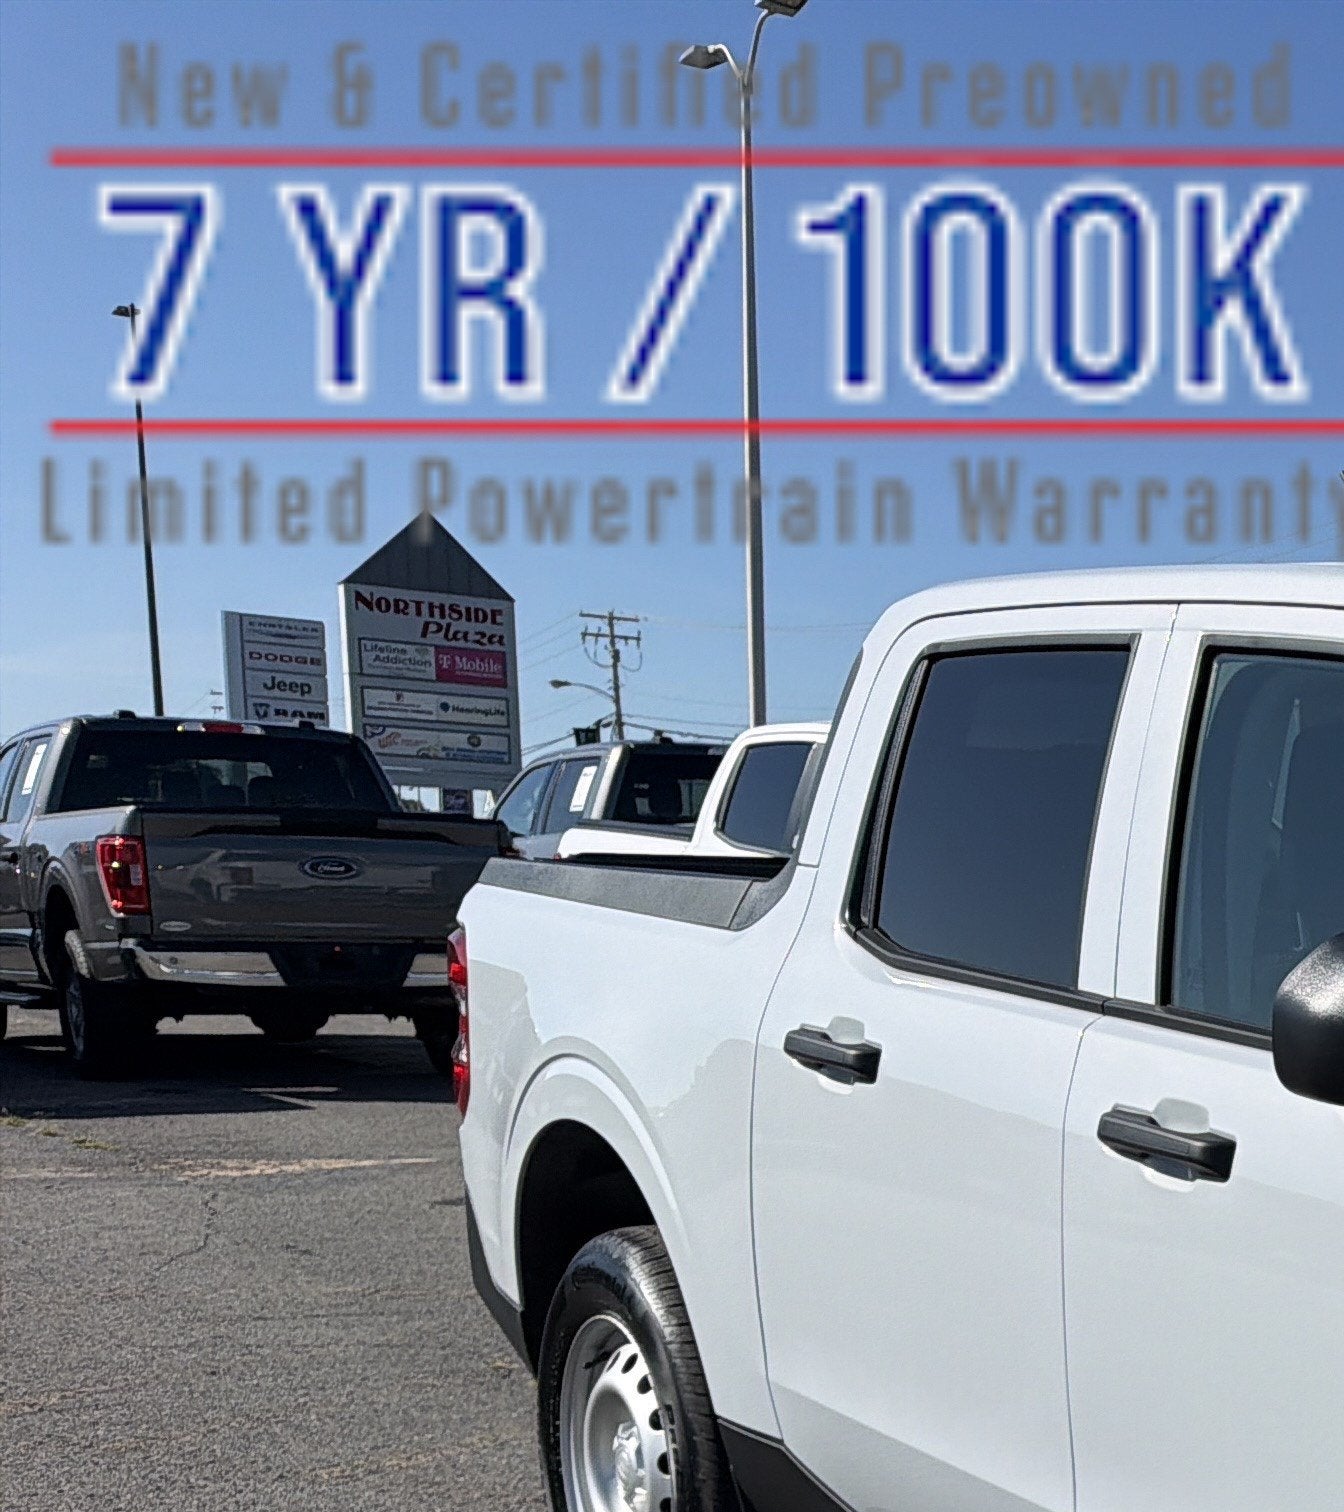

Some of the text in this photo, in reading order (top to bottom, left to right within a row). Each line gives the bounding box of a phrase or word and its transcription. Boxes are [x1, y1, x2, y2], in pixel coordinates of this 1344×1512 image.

[354, 590, 504, 627] NORTHSIDE
[421, 620, 506, 647] Plaza
[248, 651, 321, 666] DODGE
[262, 675, 312, 697] Jeep
[274, 708, 326, 720] RAM
